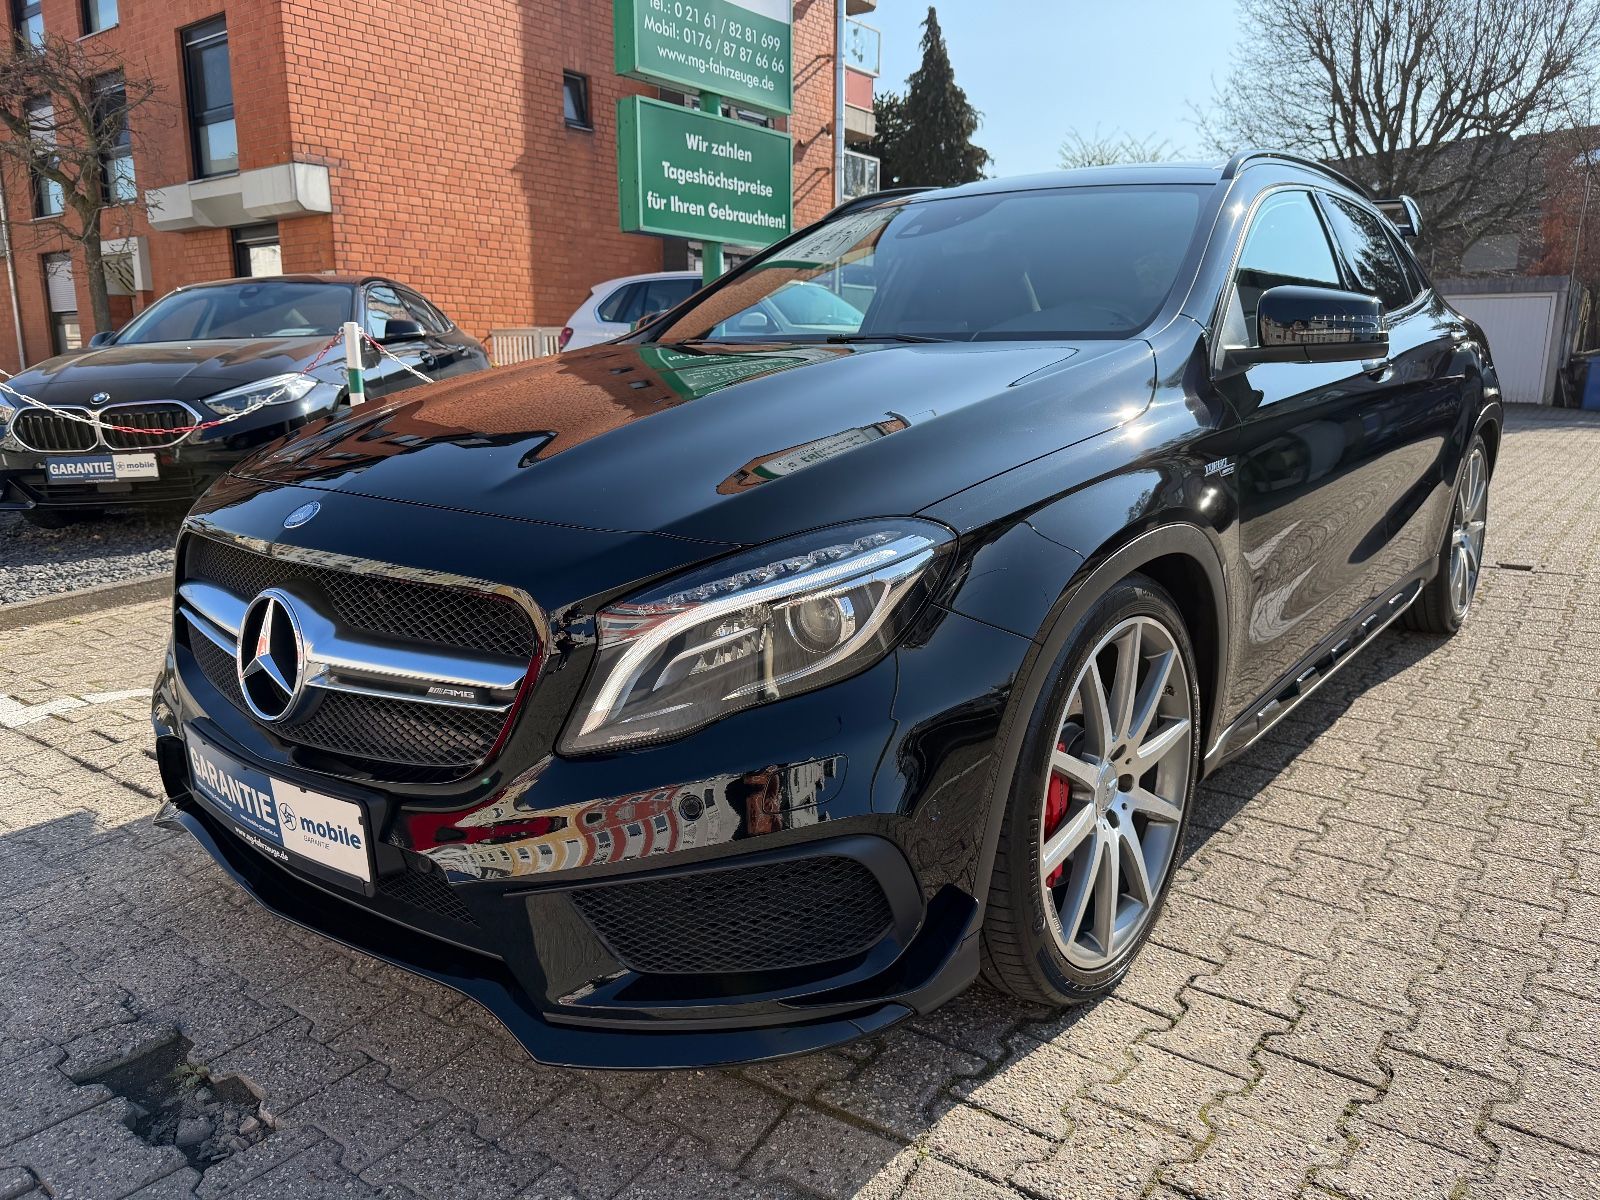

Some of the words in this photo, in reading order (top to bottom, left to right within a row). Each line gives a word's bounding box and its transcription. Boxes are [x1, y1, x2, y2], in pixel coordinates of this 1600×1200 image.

[644, 14, 680, 40] Mobil:
[683, 27, 712, 50] 0176
[723, 42, 736, 58] 87
[740, 47, 753, 63] 87
[756, 52, 769, 69] 66
[771, 57, 785, 74] 66
[674, 2, 682, 18] 0
[686, 6, 699, 24] 21
[704, 12, 716, 30] 61
[729, 21, 742, 39] 82
[745, 27, 757, 44] 81
[761, 33, 780, 51] 699
[657, 45, 775, 91] www.mg-fahrzeuge.de
[685, 132, 709, 153] Wir
[711, 141, 752, 162] zahlen
[661, 160, 773, 198] Tageshöchstpreise
[646, 190, 667, 211] für
[670, 195, 705, 217] Ihren
[707, 202, 786, 229] Gebrauchten!
[49, 461, 114, 475] GARANTIE
[190, 746, 276, 826] GARANTIE
[300, 816, 362, 850] mobile
[303, 834, 330, 850] GARANTIE
